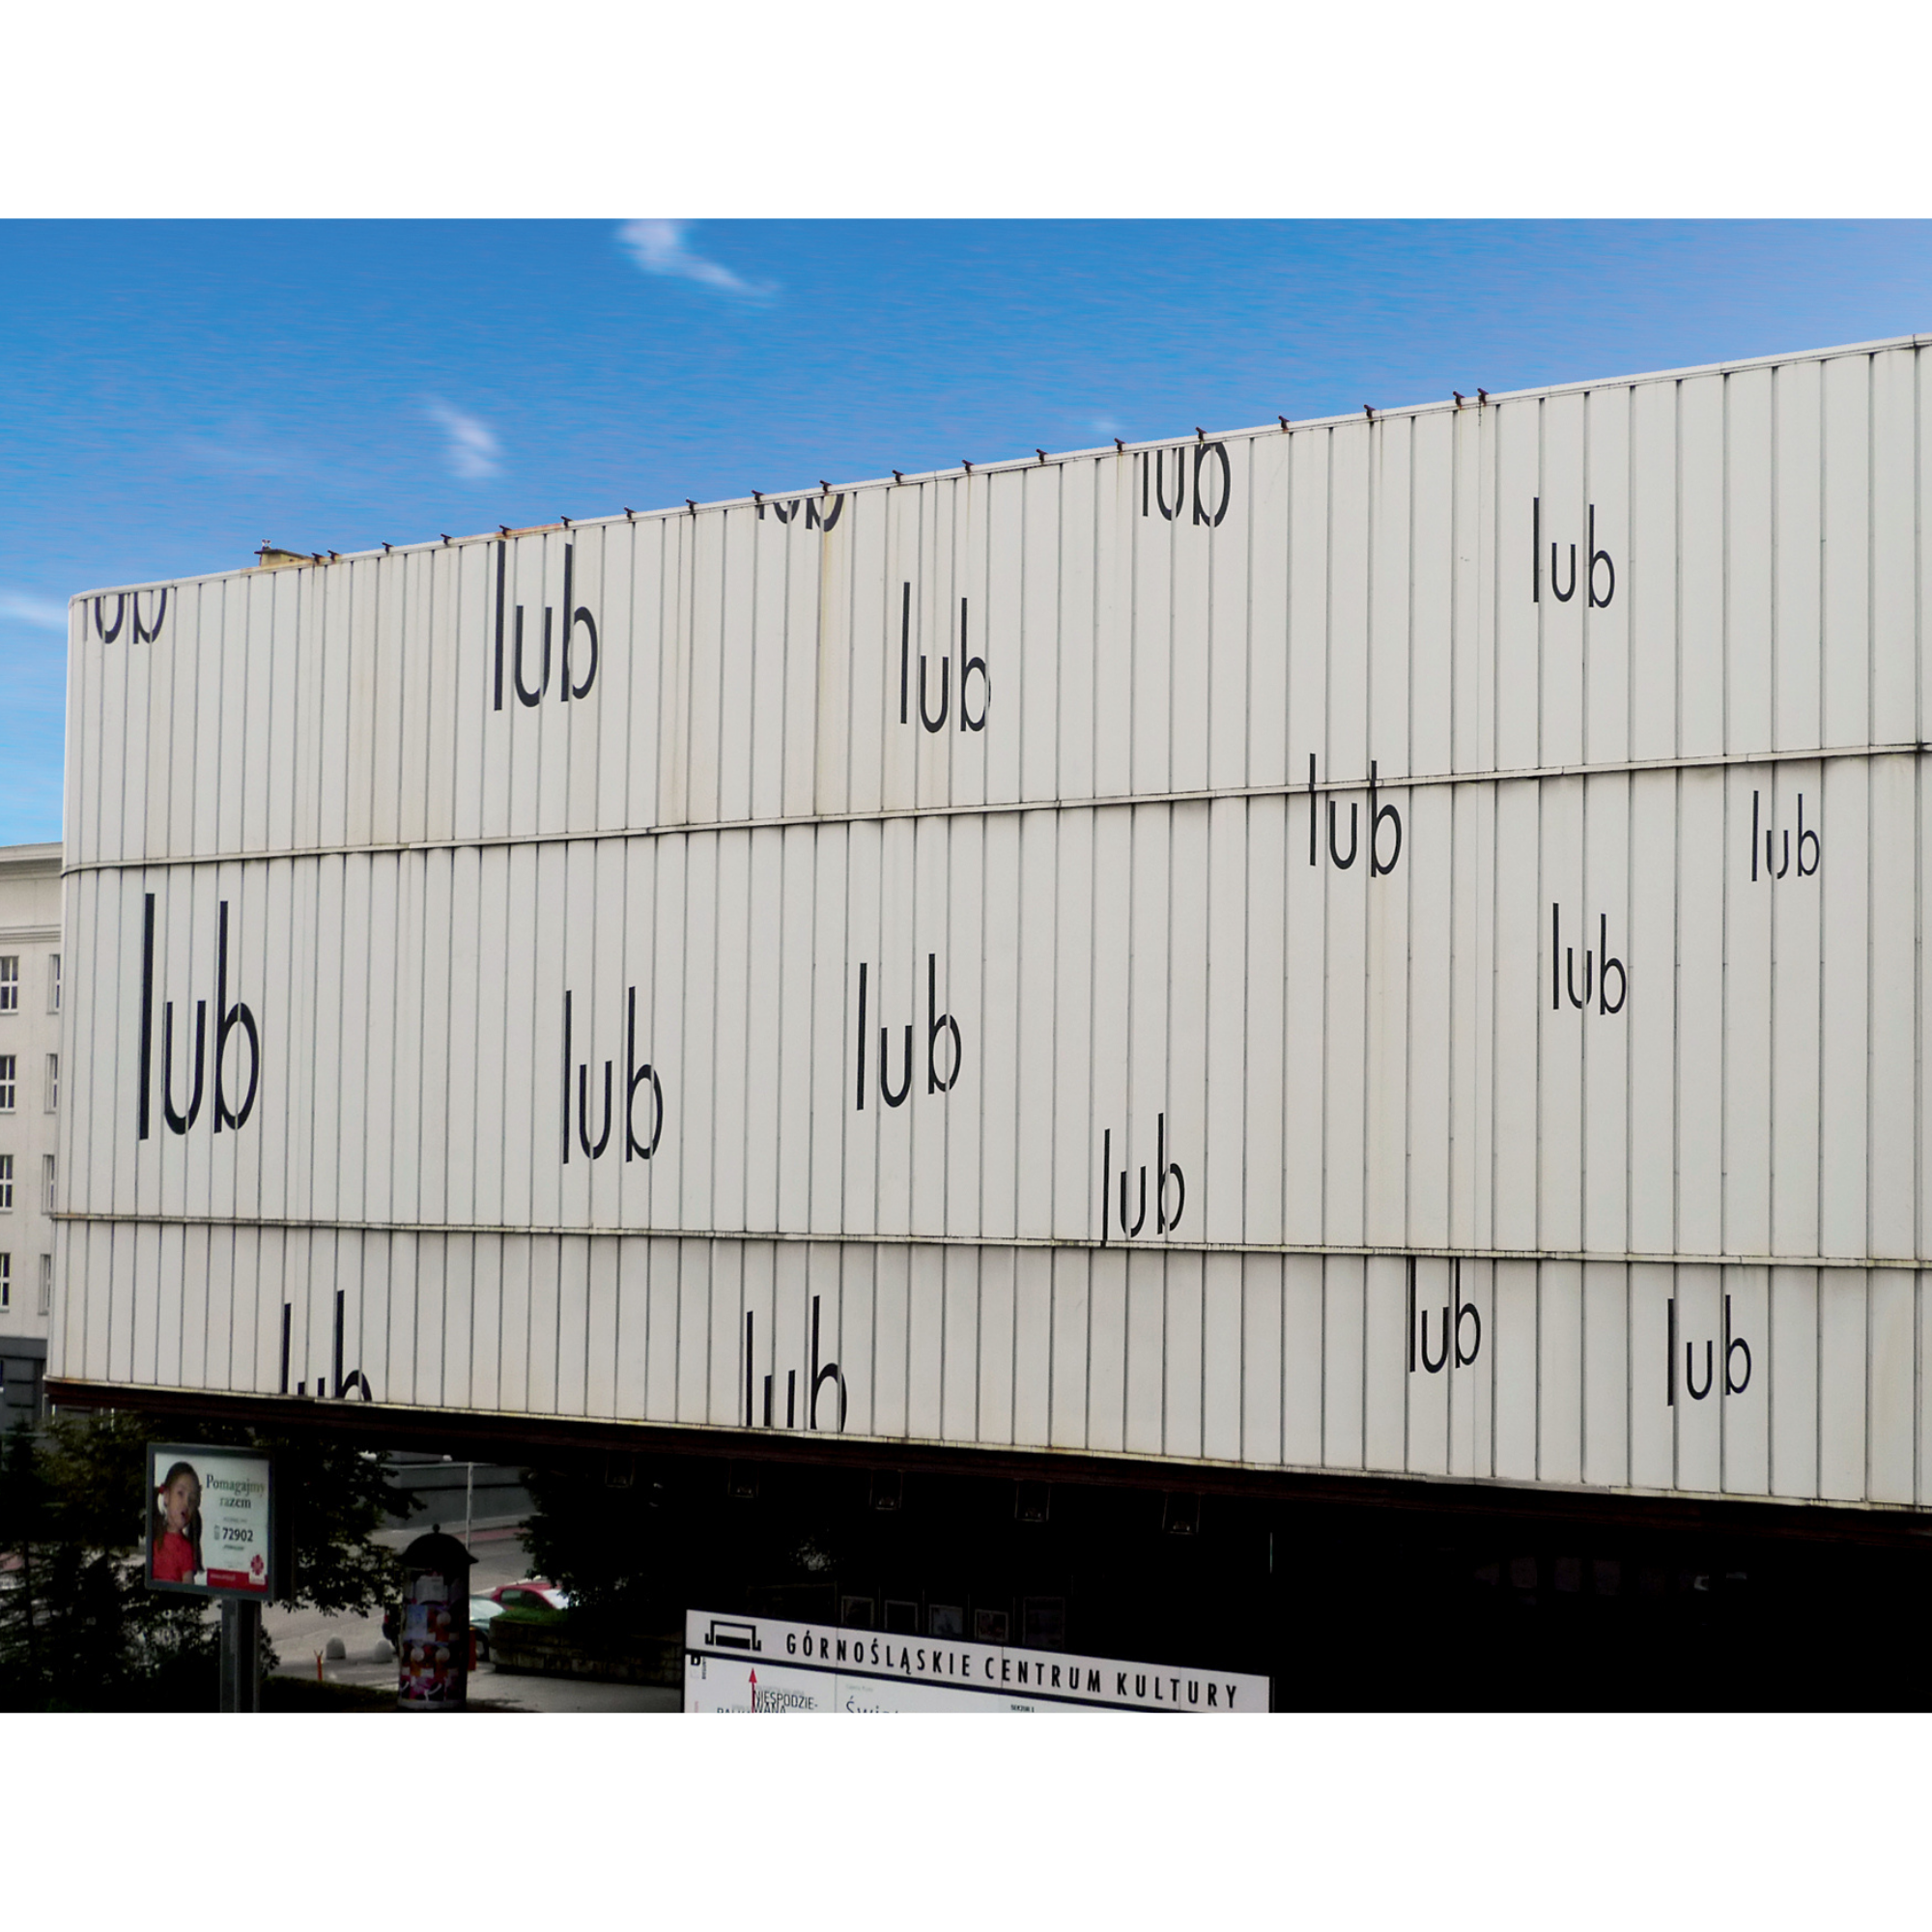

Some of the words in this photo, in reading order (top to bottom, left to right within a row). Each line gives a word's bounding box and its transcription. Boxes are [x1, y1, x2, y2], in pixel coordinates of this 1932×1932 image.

[1534, 497, 1615, 608] lub
[494, 540, 599, 711] lub
[900, 581, 991, 733] lub
[1310, 753, 1403, 877] lub
[1751, 790, 1821, 881] lub
[1552, 902, 1627, 1014] lub
[138, 893, 260, 1141] lub
[856, 952, 962, 1111] lub
[560, 986, 664, 1165] lub
[1101, 1112, 1186, 1247] lub
[1408, 1256, 1482, 1374] lub
[1665, 1294, 1752, 1406] lub
[206, 1473, 267, 1497] Pomagajmy
[219, 1497, 252, 1509] razem
[222, 1526, 254, 1543] 72902
[785, 1629, 971, 1678] GÓRNOŚLĄSKIE
[984, 1656, 1102, 1693] CENTRUM
[1117, 1672, 1239, 1710] KULTURY
